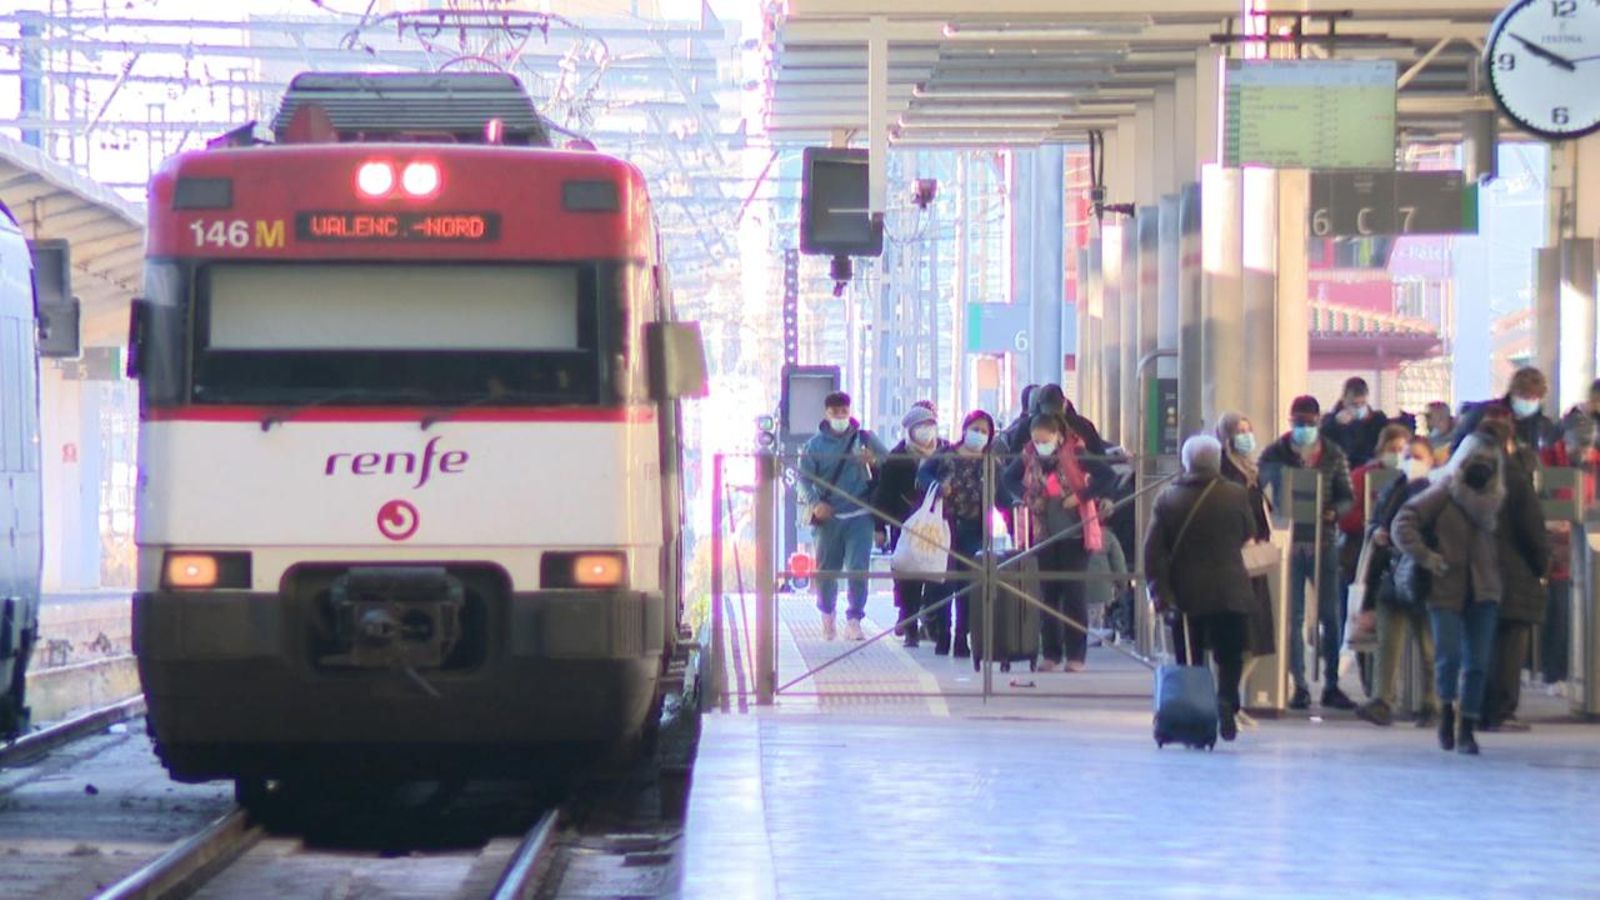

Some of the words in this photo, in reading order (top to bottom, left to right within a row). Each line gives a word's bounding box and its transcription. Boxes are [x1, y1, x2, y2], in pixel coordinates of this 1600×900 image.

[1552, 0, 1577, 17] 12
[1499, 53, 1516, 71] 9
[1552, 107, 1569, 125] 6
[1313, 208, 1329, 236] 6
[1357, 207, 1373, 234] C
[1399, 206, 1416, 234] 7
[1014, 330, 1029, 352] 6
[325, 435, 469, 489] renfe
